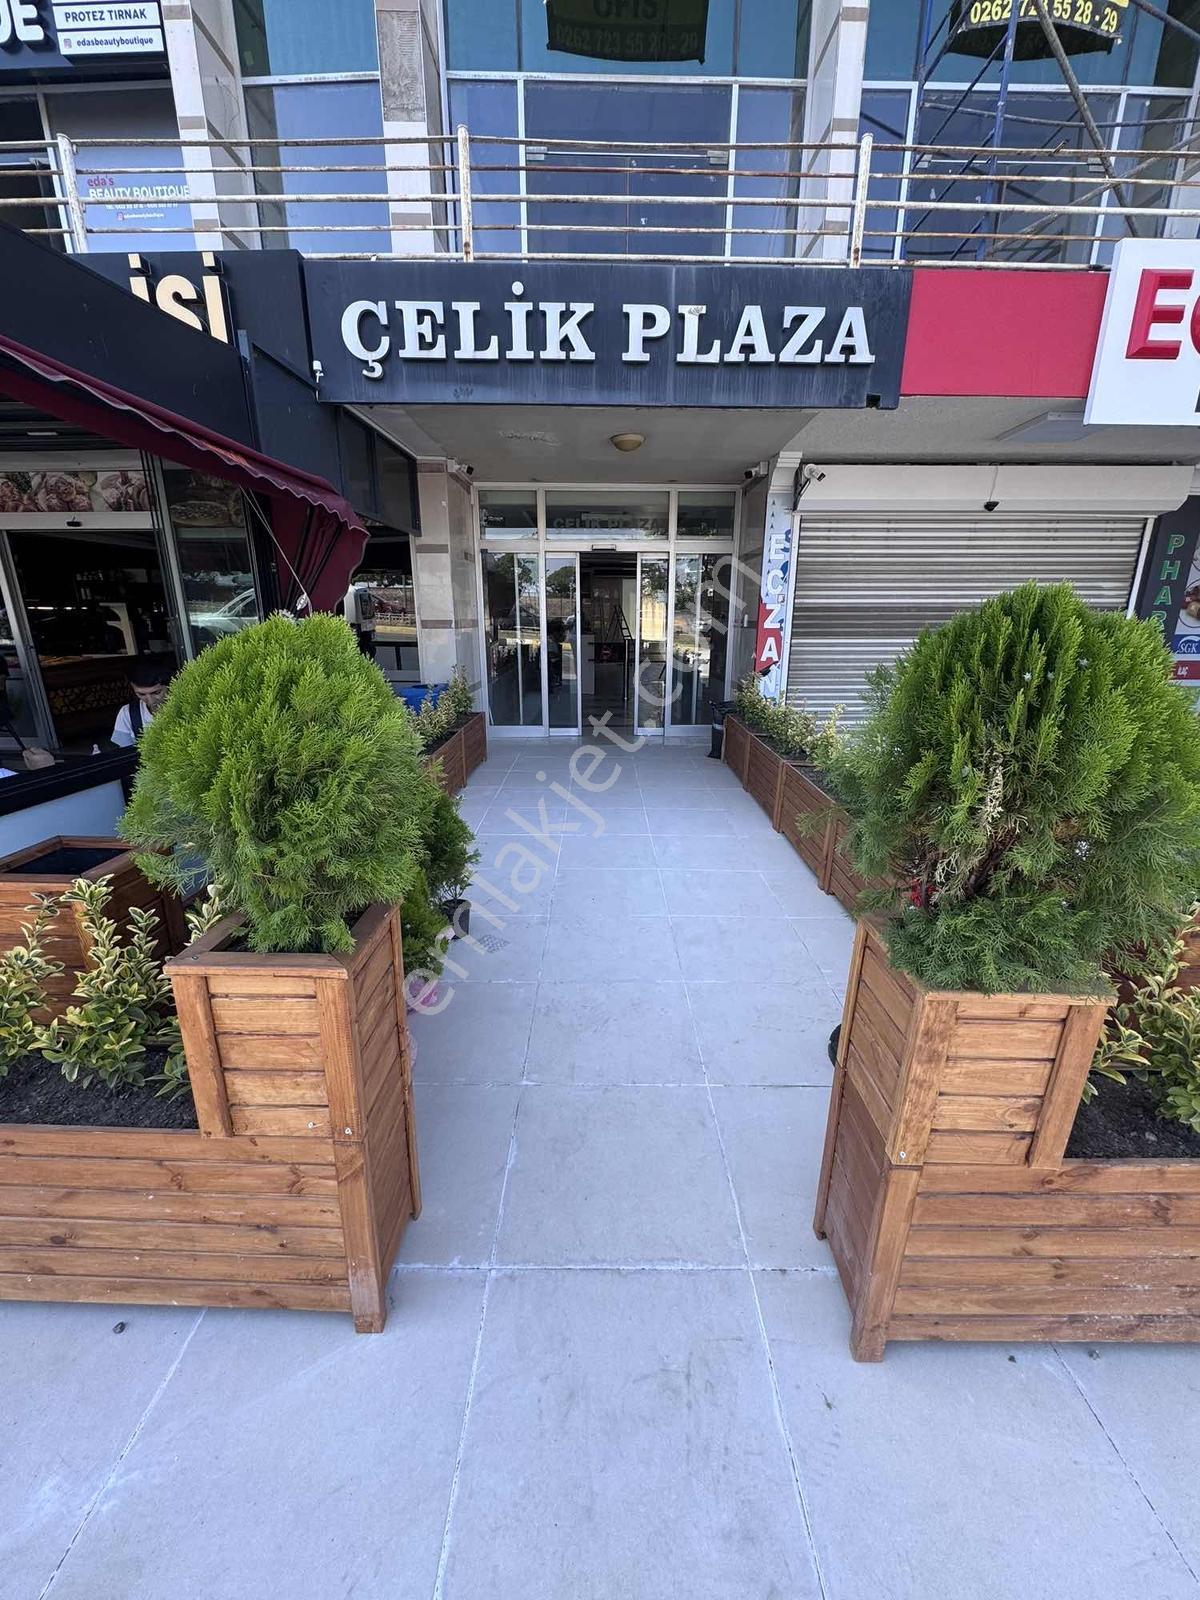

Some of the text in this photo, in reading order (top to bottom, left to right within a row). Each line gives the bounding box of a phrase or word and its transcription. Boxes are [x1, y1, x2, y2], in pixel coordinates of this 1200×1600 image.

[64, 8, 148, 23] PROTEZ TIRNAK
[970, 0, 1012, 24] 0262
[1073, 0, 1093, 24] 28
[1100, 7, 1118, 33] 29
[76, 36, 154, 48] edasbeautyboutique
[88, 184, 191, 199] BEAUTY BOUTIQUE
[1125, 268, 1200, 360] E
[341, 281, 876, 379] ÇELİK PLAZA
[1178, 642, 1199, 655] SGK
